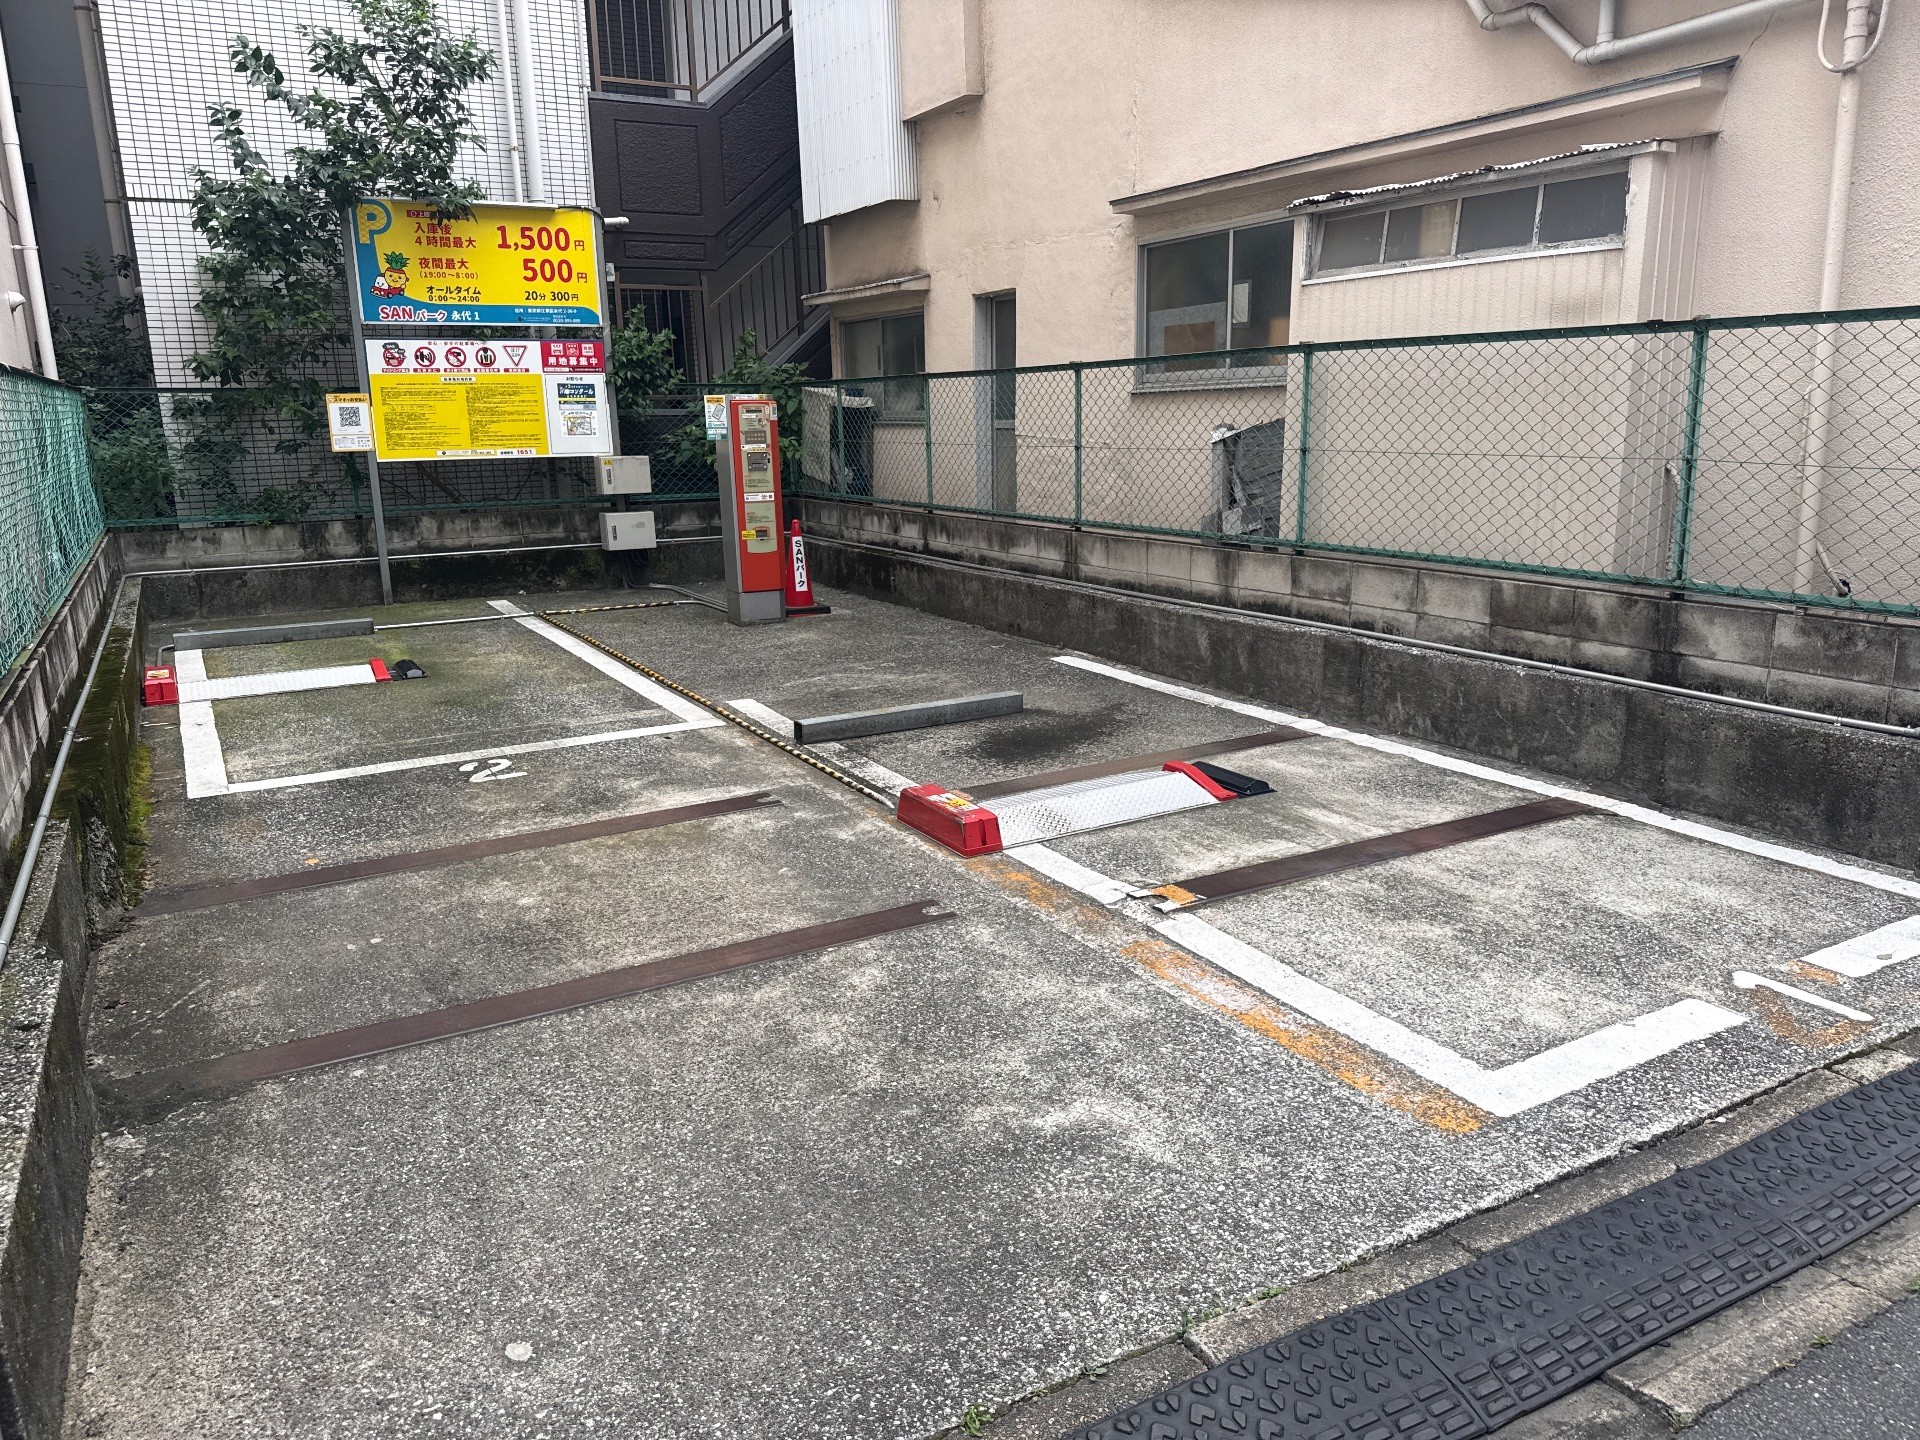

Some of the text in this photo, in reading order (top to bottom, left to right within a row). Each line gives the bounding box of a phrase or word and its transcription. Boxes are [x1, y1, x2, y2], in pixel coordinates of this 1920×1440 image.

[414, 222, 452, 235] 入庫後
[418, 257, 469, 270] 夜間最大
[426, 285, 482, 295] オールタイム
[524, 291, 579, 302] 20分 300円
[548, 356, 598, 366] 用地募集中
